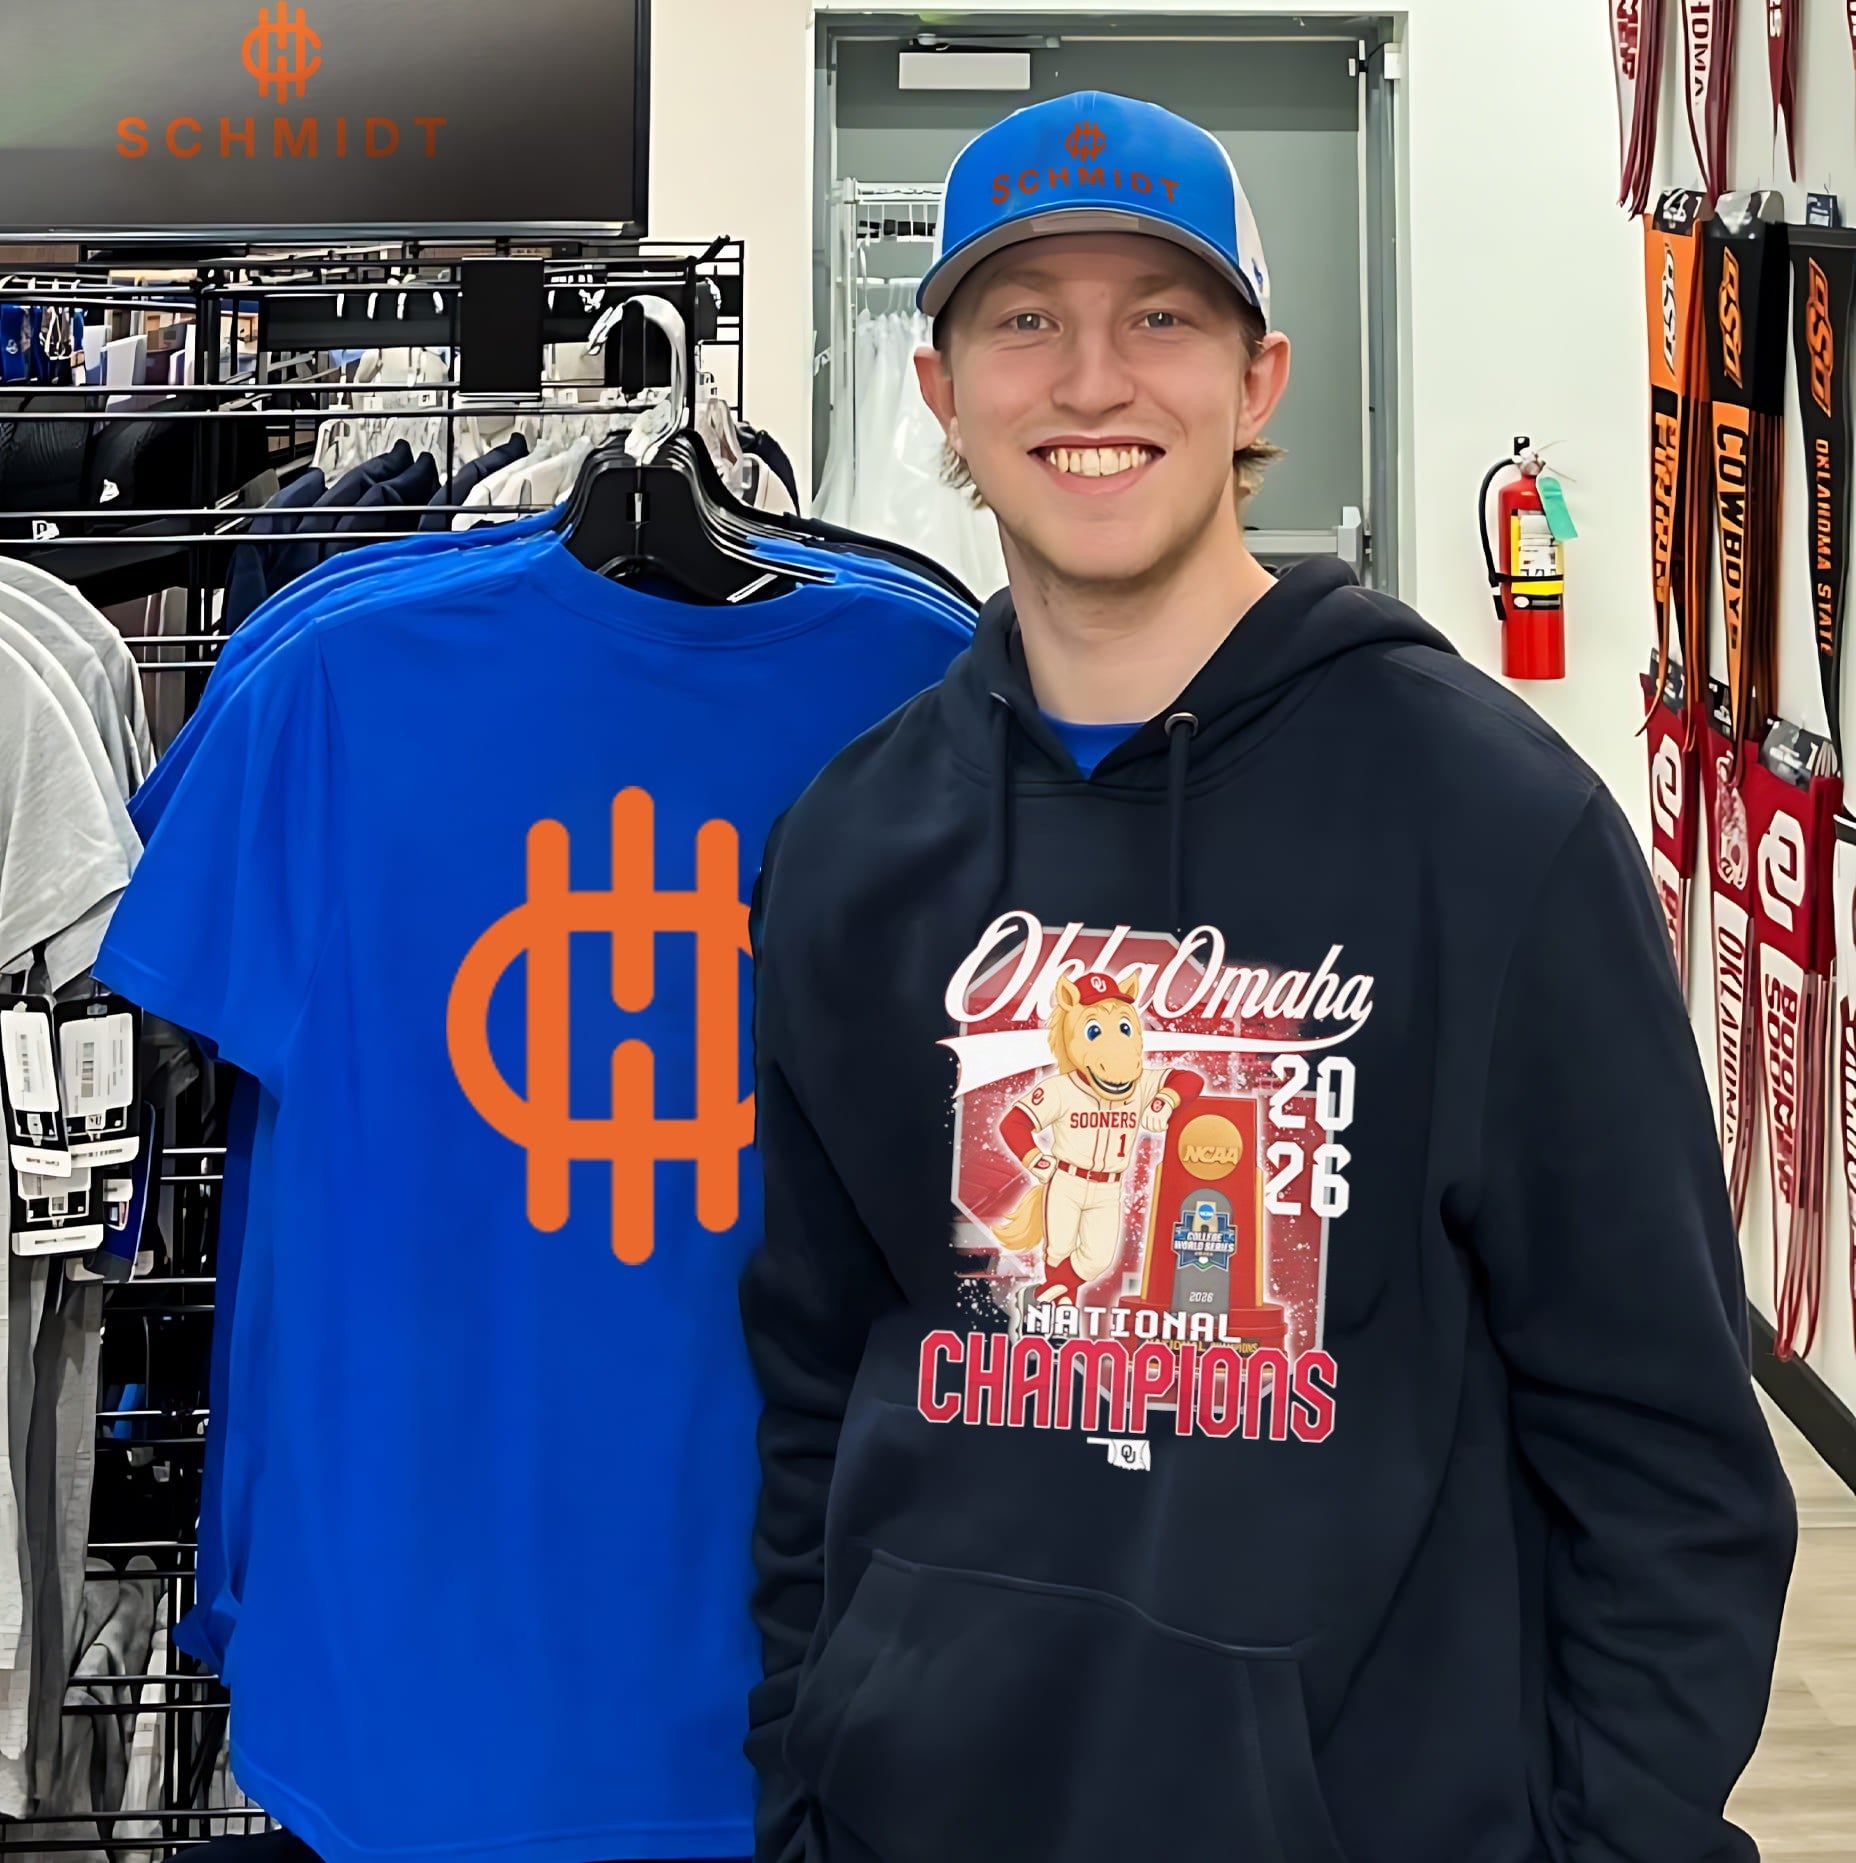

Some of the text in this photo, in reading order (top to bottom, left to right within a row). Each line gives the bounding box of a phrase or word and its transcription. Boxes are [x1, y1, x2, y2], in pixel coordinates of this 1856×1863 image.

[116, 116, 448, 159] SCHMIDT
[991, 166, 1179, 205] SCHMIDT
[1268, 1053, 1357, 1132] 20
[1069, 1111, 1137, 1130] SOONERS
[1116, 1133, 1127, 1158] 1
[1181, 1144, 1240, 1166] NCAA
[1262, 1140, 1352, 1218] 26
[1174, 1240, 1236, 1252] WORLD SERIES
[1187, 1231, 1224, 1242] COLLEGE
[1188, 1291, 1215, 1303] 2026
[1025, 1303, 1243, 1344] NATIONAL
[917, 1329, 1338, 1443] CHAMPIONS
